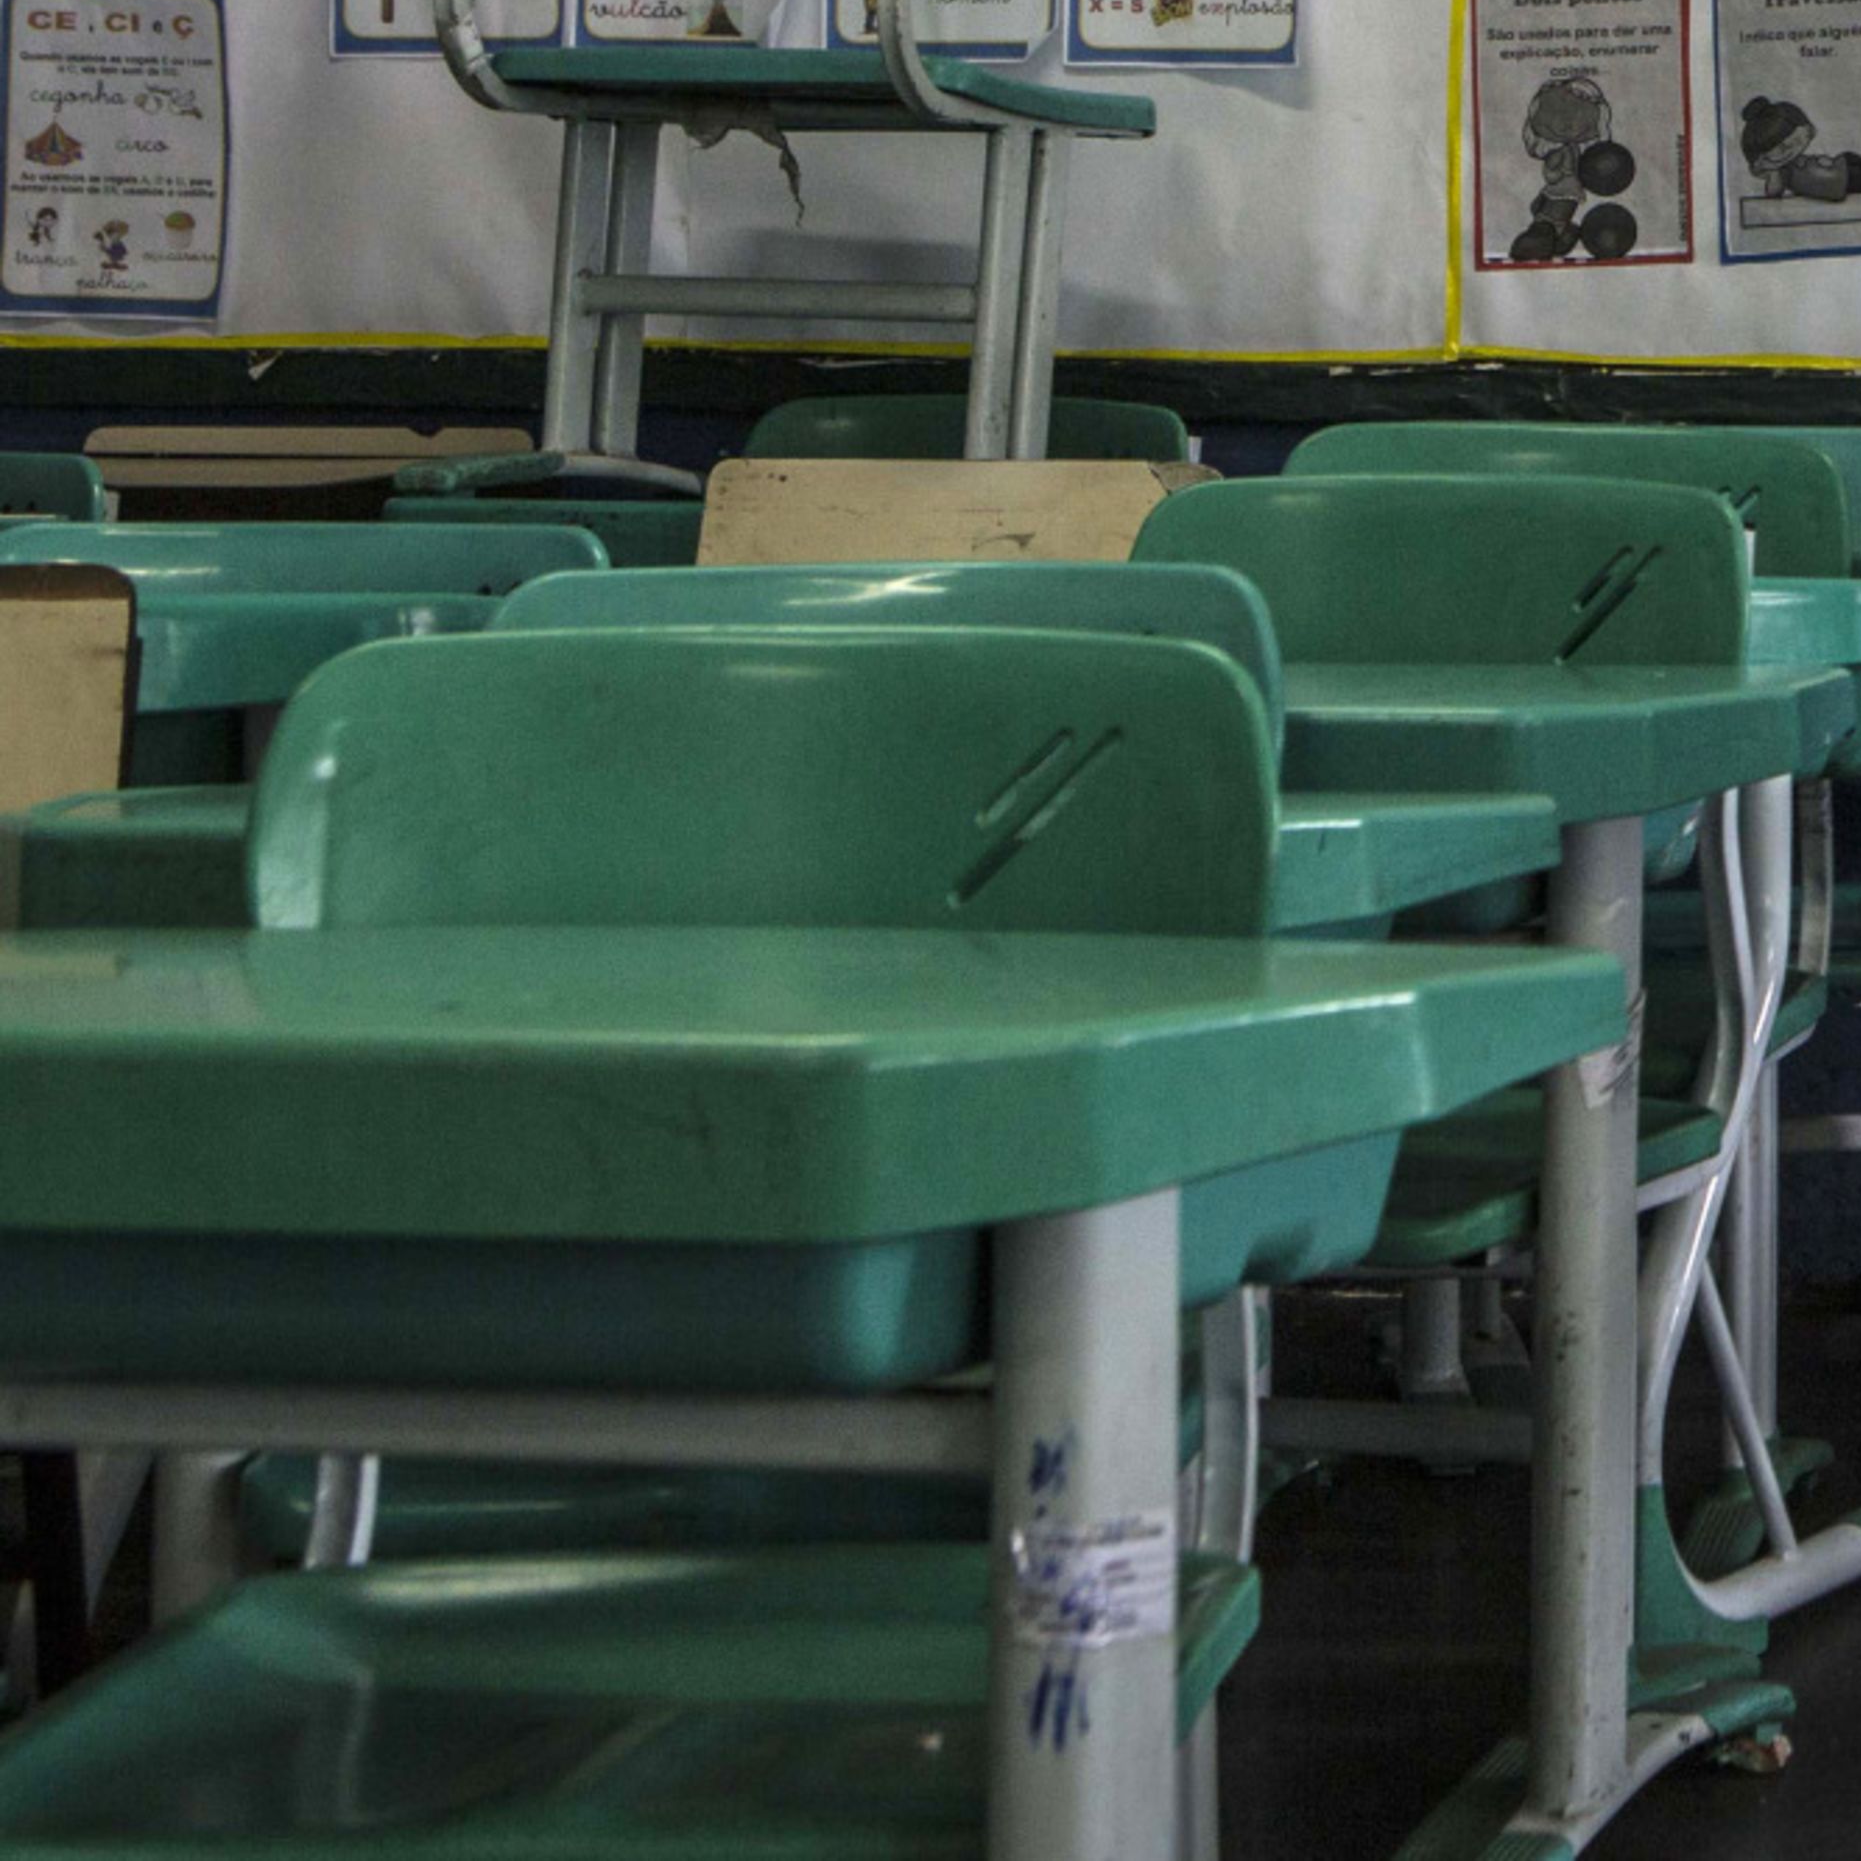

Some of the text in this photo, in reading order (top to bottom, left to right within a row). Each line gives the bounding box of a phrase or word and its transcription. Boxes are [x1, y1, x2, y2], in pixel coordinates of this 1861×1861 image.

[27, 11, 78, 33] CE
[105, 11, 141, 33] CI
[171, 13, 196, 38] Ç
[29, 84, 126, 112] cegonha
